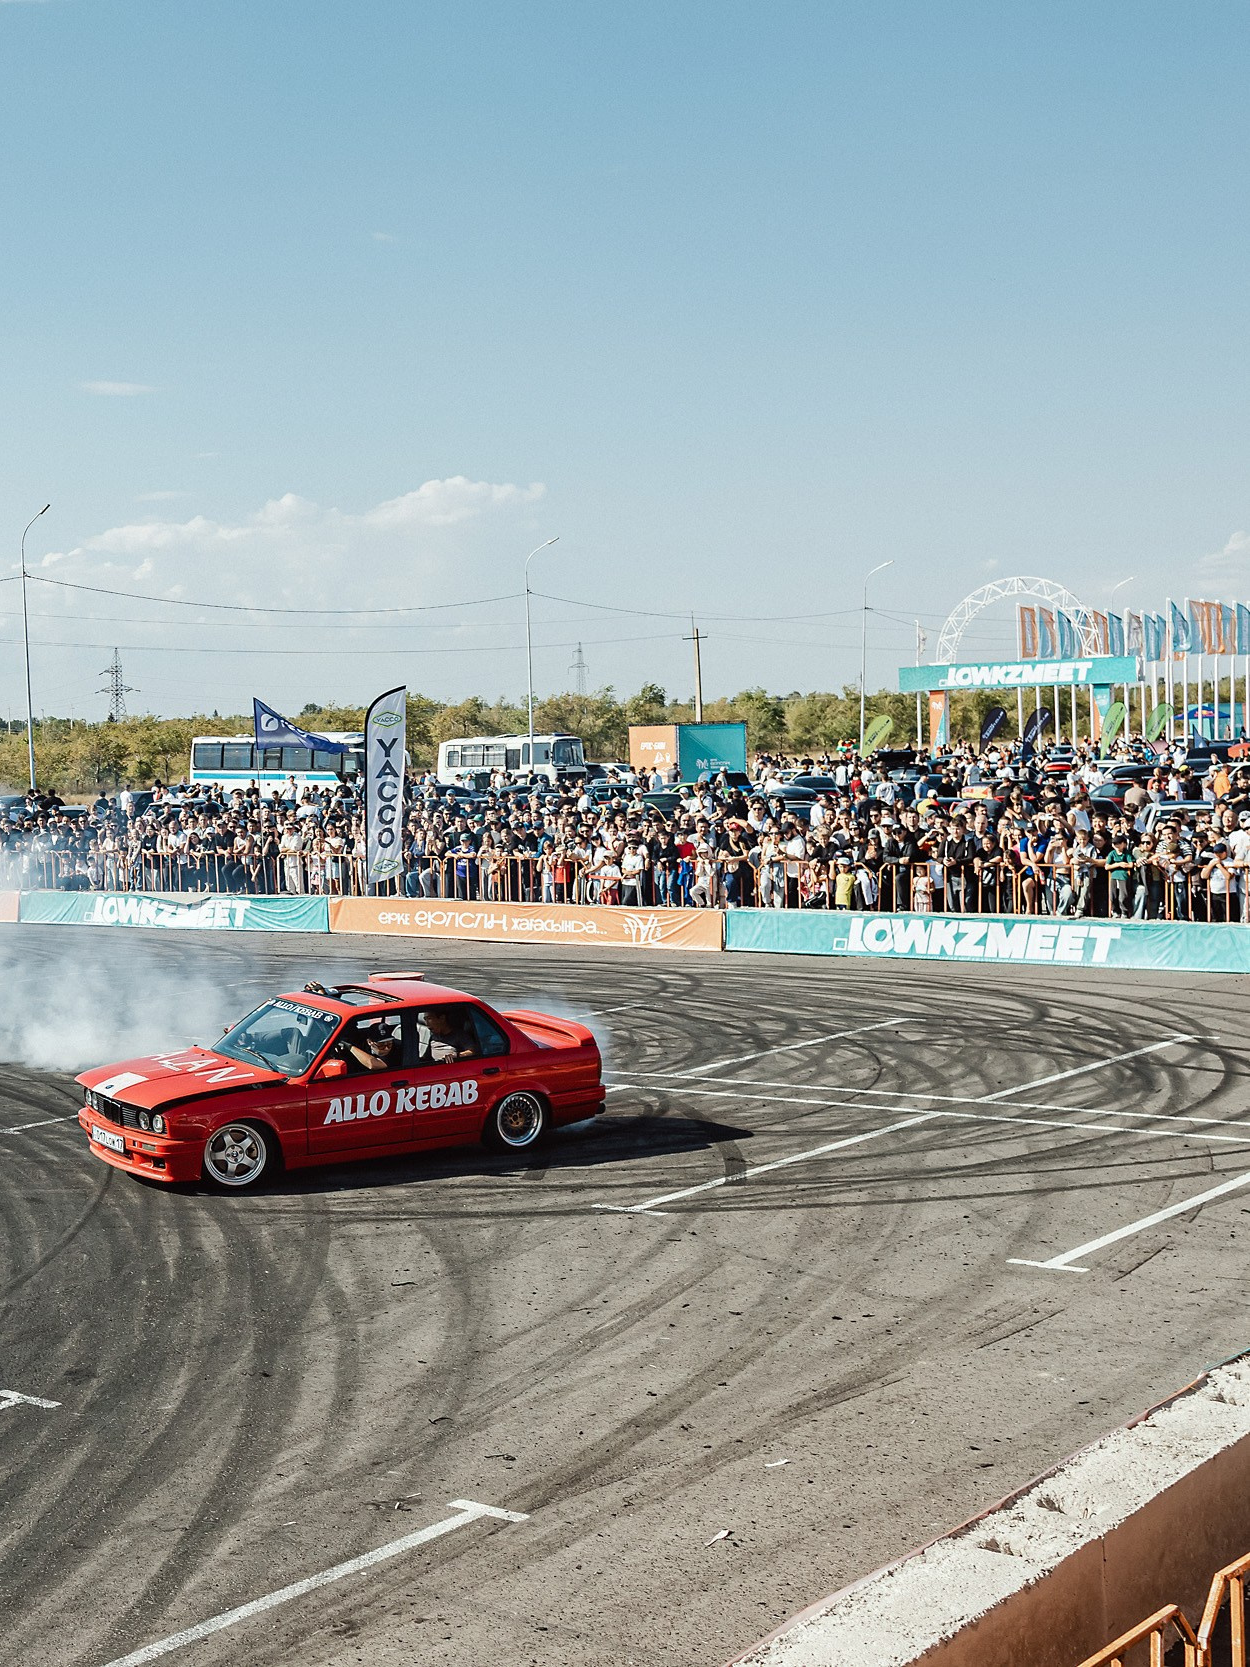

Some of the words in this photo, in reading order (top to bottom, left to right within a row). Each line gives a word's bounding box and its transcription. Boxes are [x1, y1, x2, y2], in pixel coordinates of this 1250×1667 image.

[946, 661, 1093, 687] LOWKZMEET
[375, 737, 400, 849] YACCO
[847, 917, 1122, 963] LOWKZMEET
[150, 1050, 255, 1084] ALAN
[323, 1090, 391, 1125] ALLO
[395, 1079, 479, 1113] KEBAB
